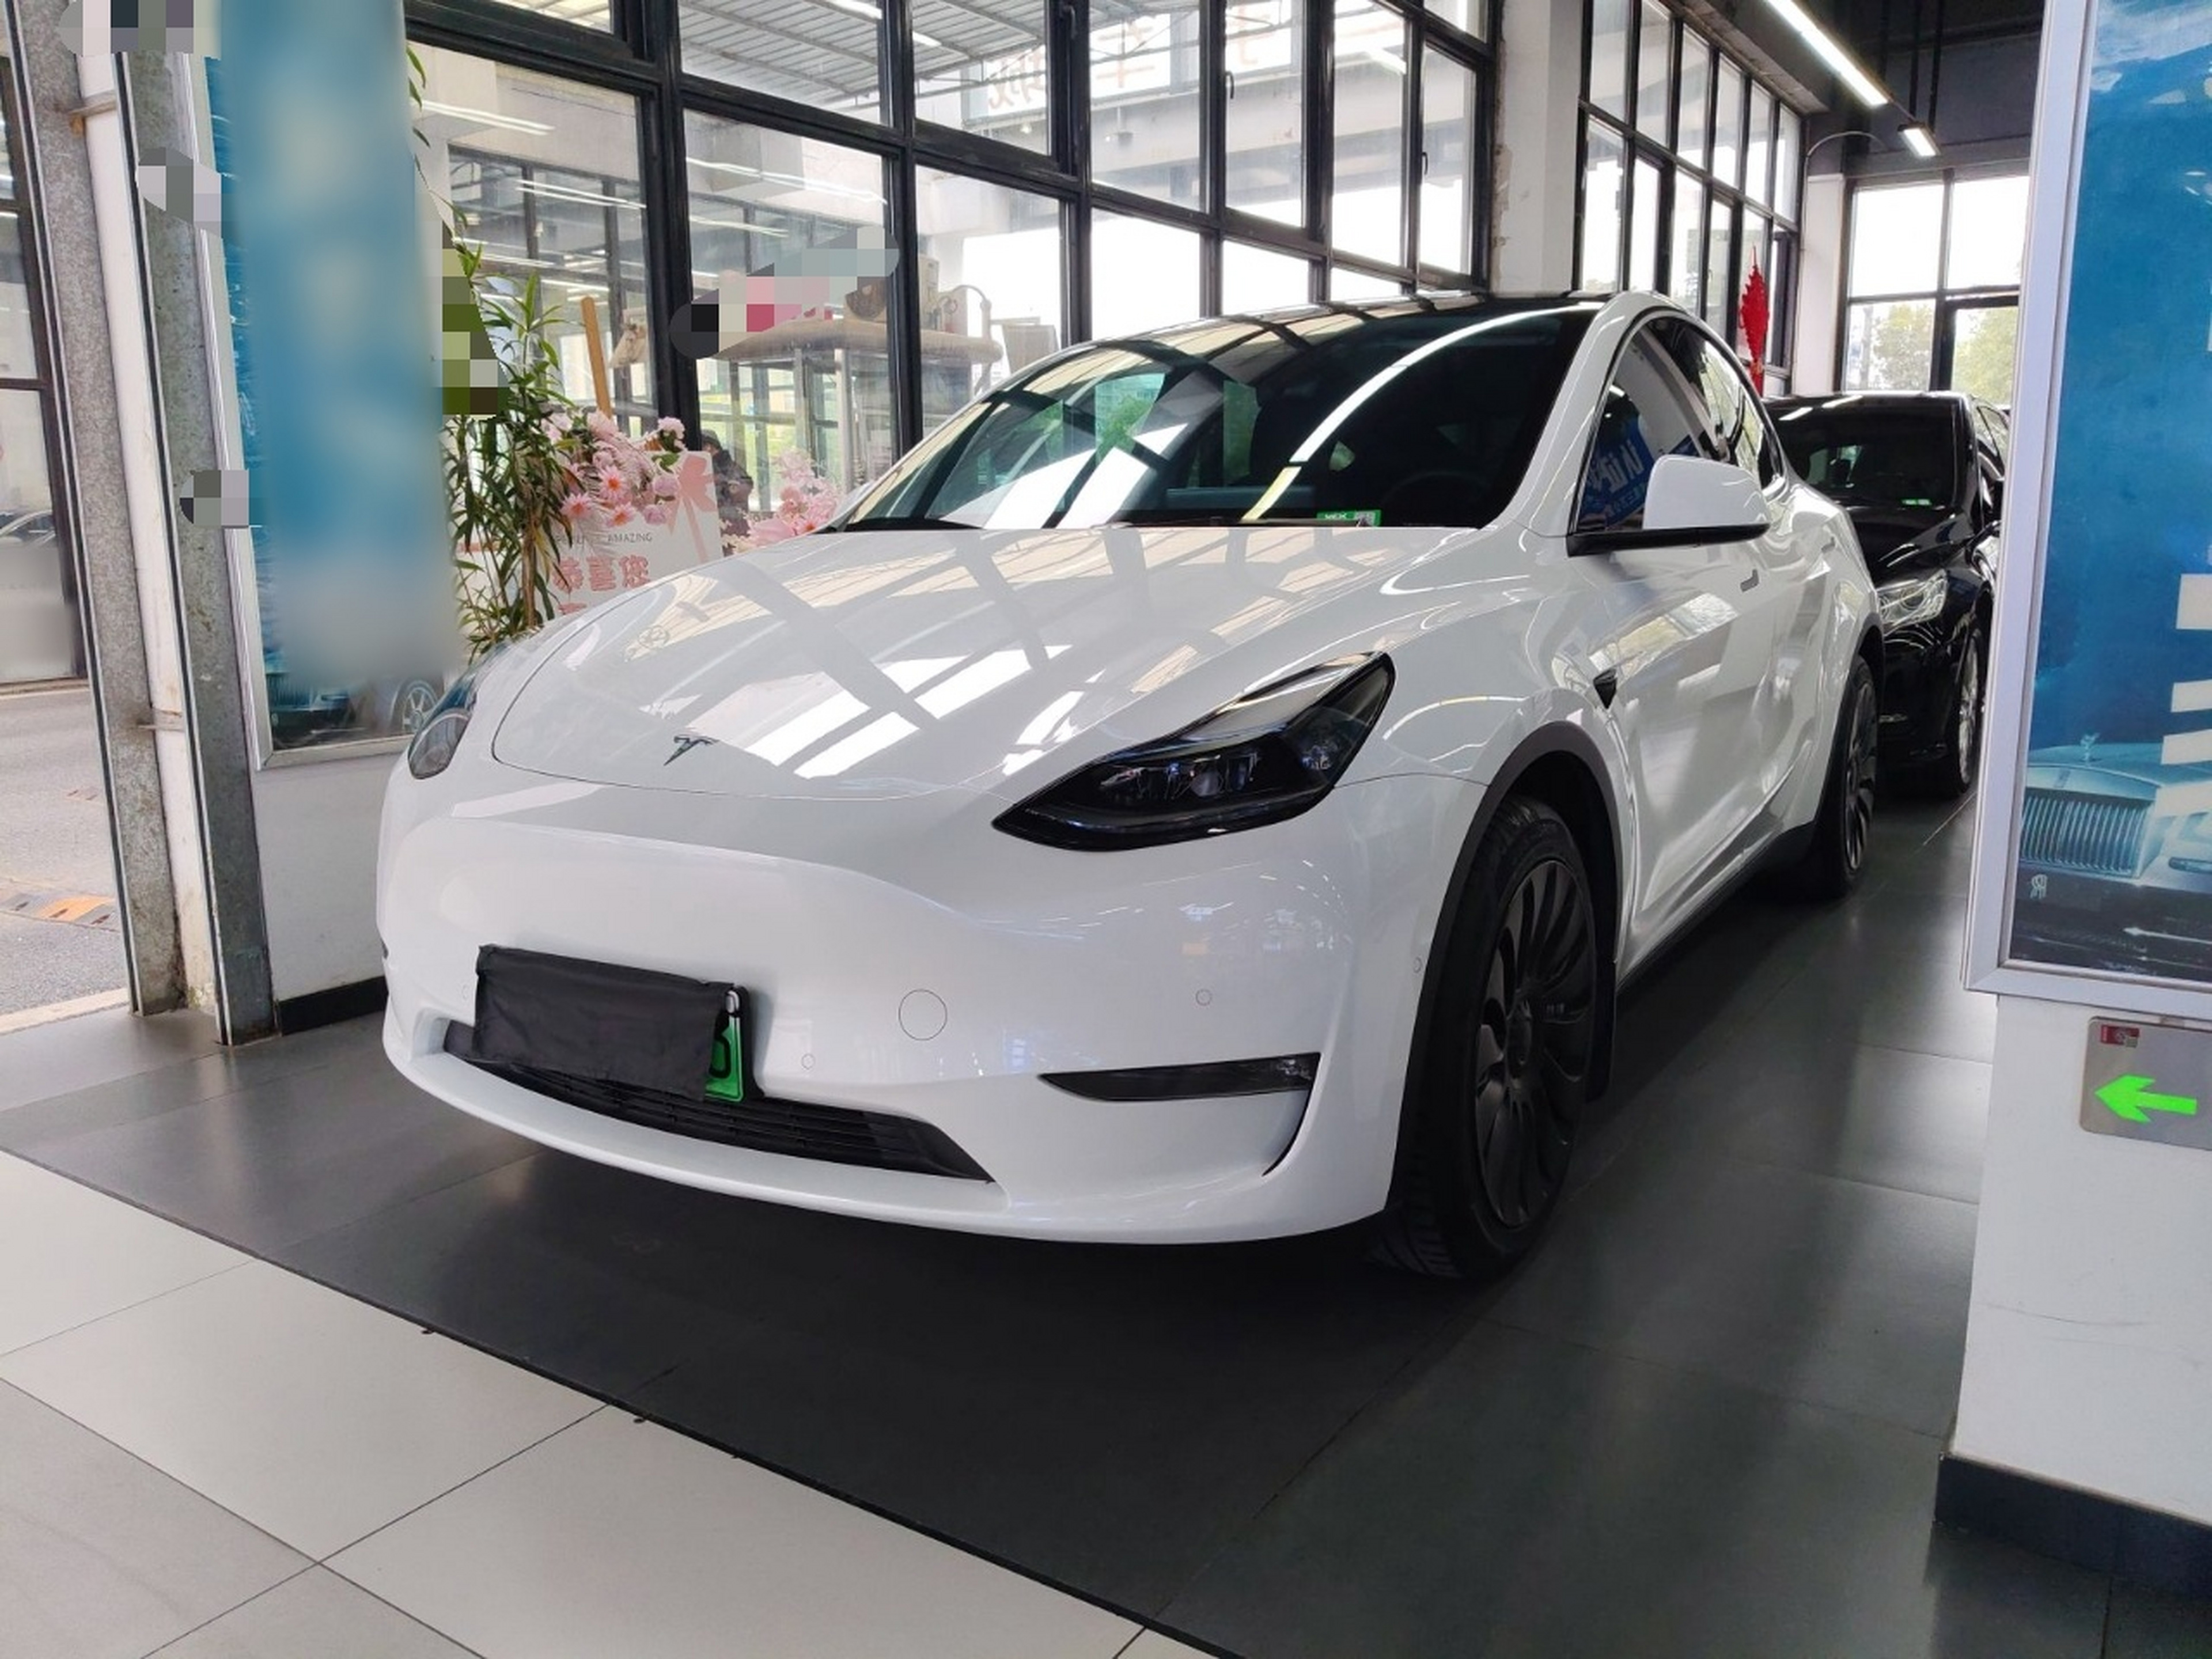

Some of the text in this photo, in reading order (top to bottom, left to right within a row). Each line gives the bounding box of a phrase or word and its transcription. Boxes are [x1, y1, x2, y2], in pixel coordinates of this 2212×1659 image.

[608, 532, 652, 543] AMAZING
[552, 555, 650, 593] 恭喜您
